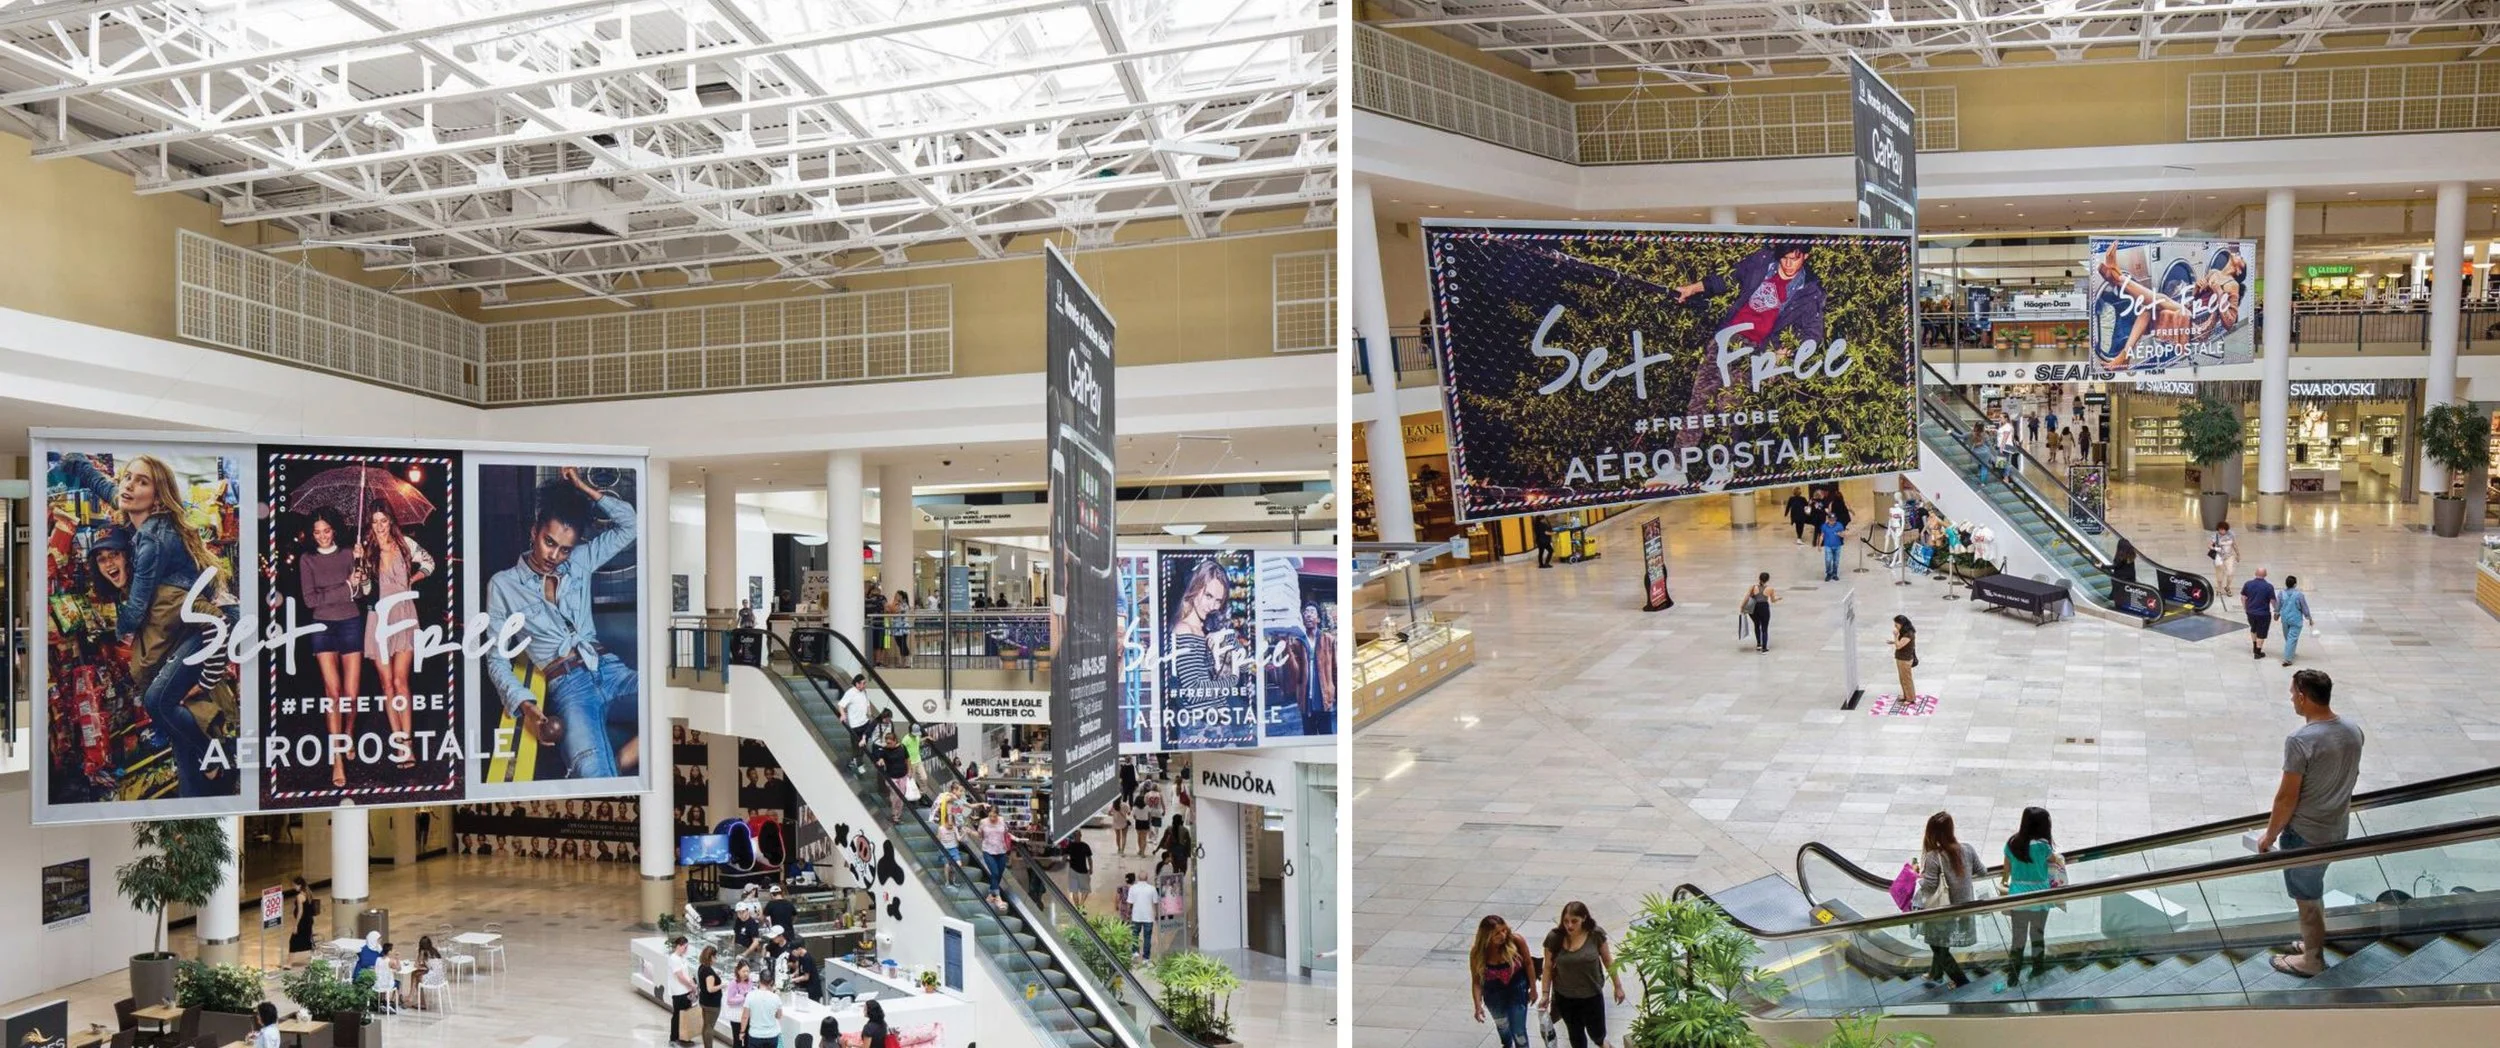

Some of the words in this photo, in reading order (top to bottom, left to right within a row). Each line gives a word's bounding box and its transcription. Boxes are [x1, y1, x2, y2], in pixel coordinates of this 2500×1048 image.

[1872, 128, 1903, 184] CarPlay
[2023, 300, 2071, 309] Häagen-Dazs
[2119, 275, 2166, 321] Set
[2181, 284, 2231, 319] Free
[1531, 304, 1673, 401] Set
[1715, 322, 1854, 394] Free
[2125, 340, 2225, 360] AÉROPOSTALE
[1987, 370, 2007, 378] GAP
[1068, 347, 1102, 429] CarPlay
[2146, 381, 2194, 395] SWAROVSKI
[2290, 383, 2375, 396] SWAROVSKI
[1635, 409, 1779, 434] #FREETOBE
[1565, 434, 1843, 487] AÉROPOSTALE
[2124, 585, 2148, 597] Caution
[2169, 576, 2193, 587] Caution
[180, 566, 328, 676] Set
[375, 591, 532, 674] Free
[1123, 616, 1189, 677] Set
[1211, 631, 1290, 677] Free
[961, 698, 1009, 707] AMERICAN
[1012, 699, 1042, 707] EAGLE
[1170, 687, 1247, 699] #FREETOBE
[281, 694, 444, 715] #FREETOBE
[967, 708, 1017, 717] HOLLISTER
[1020, 709, 1036, 717] CO.
[200, 727, 515, 771] AÉROPOSTALE
[1202, 771, 1276, 796] PANDORA
